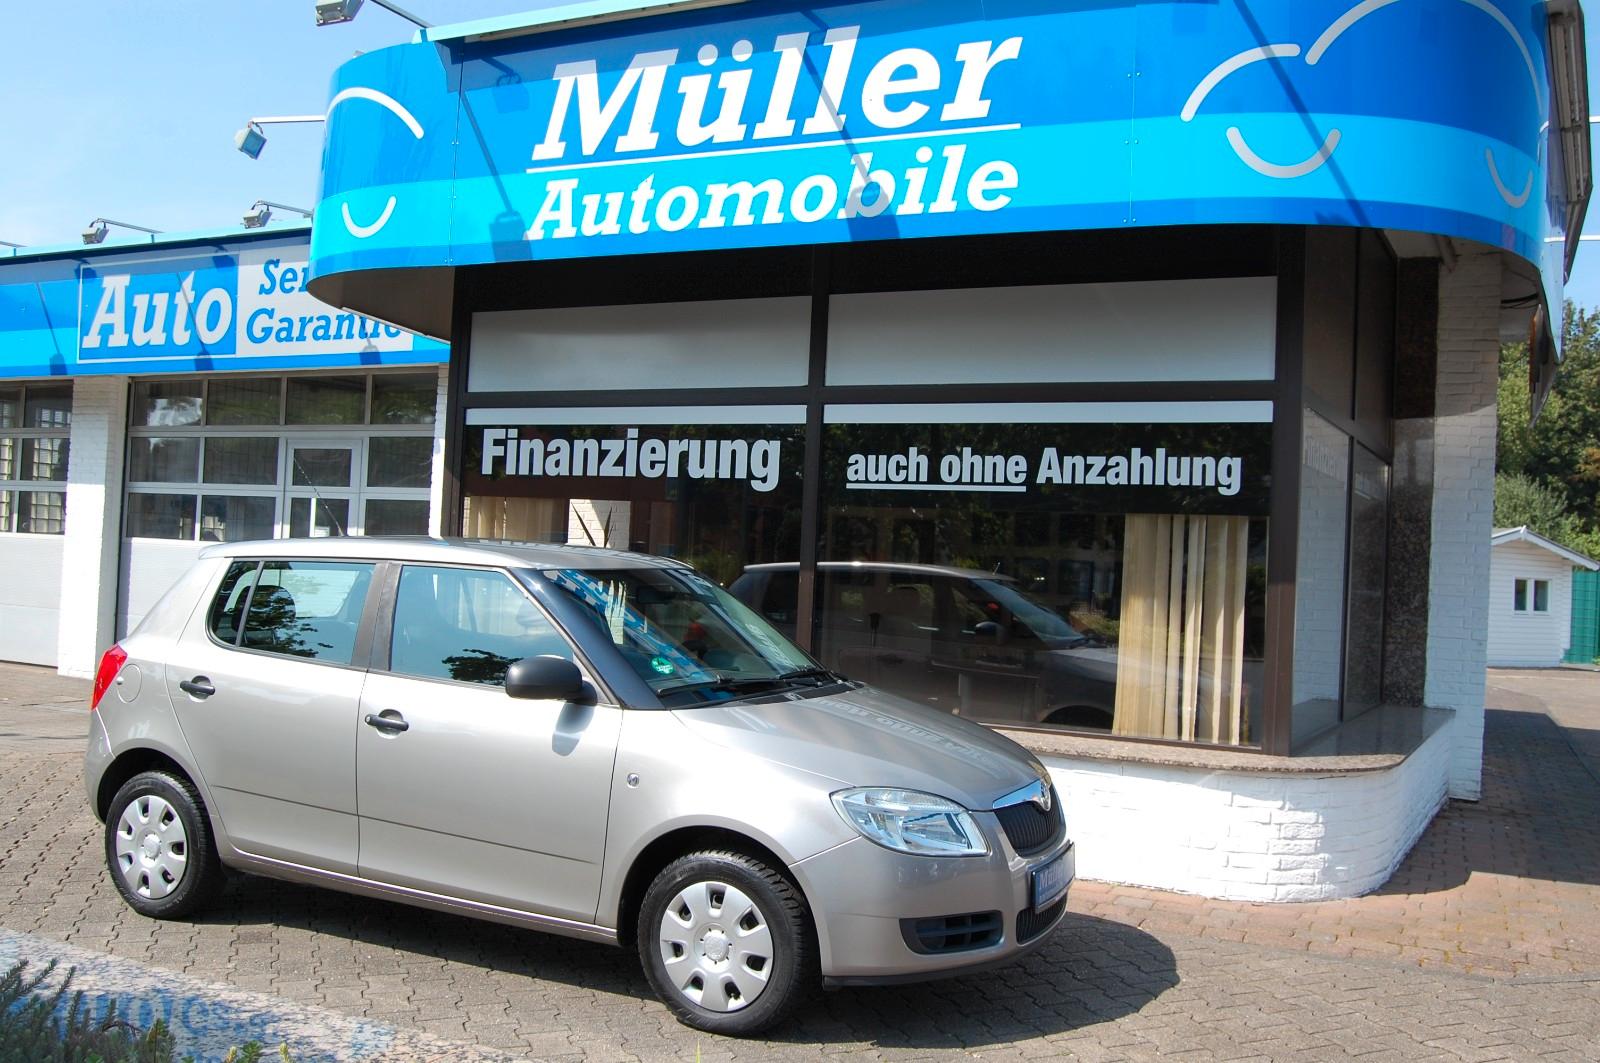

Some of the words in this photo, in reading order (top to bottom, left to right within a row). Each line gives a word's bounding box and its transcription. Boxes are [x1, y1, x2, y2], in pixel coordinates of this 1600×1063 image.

[531, 25, 1024, 161] Müller
[523, 143, 1019, 241] Automobile
[82, 271, 232, 349] Auto
[481, 428, 781, 492] Finanzierung
[846, 447, 928, 482] auch
[940, 447, 1027, 484] ohne
[1036, 447, 1242, 496] Anzahlung
